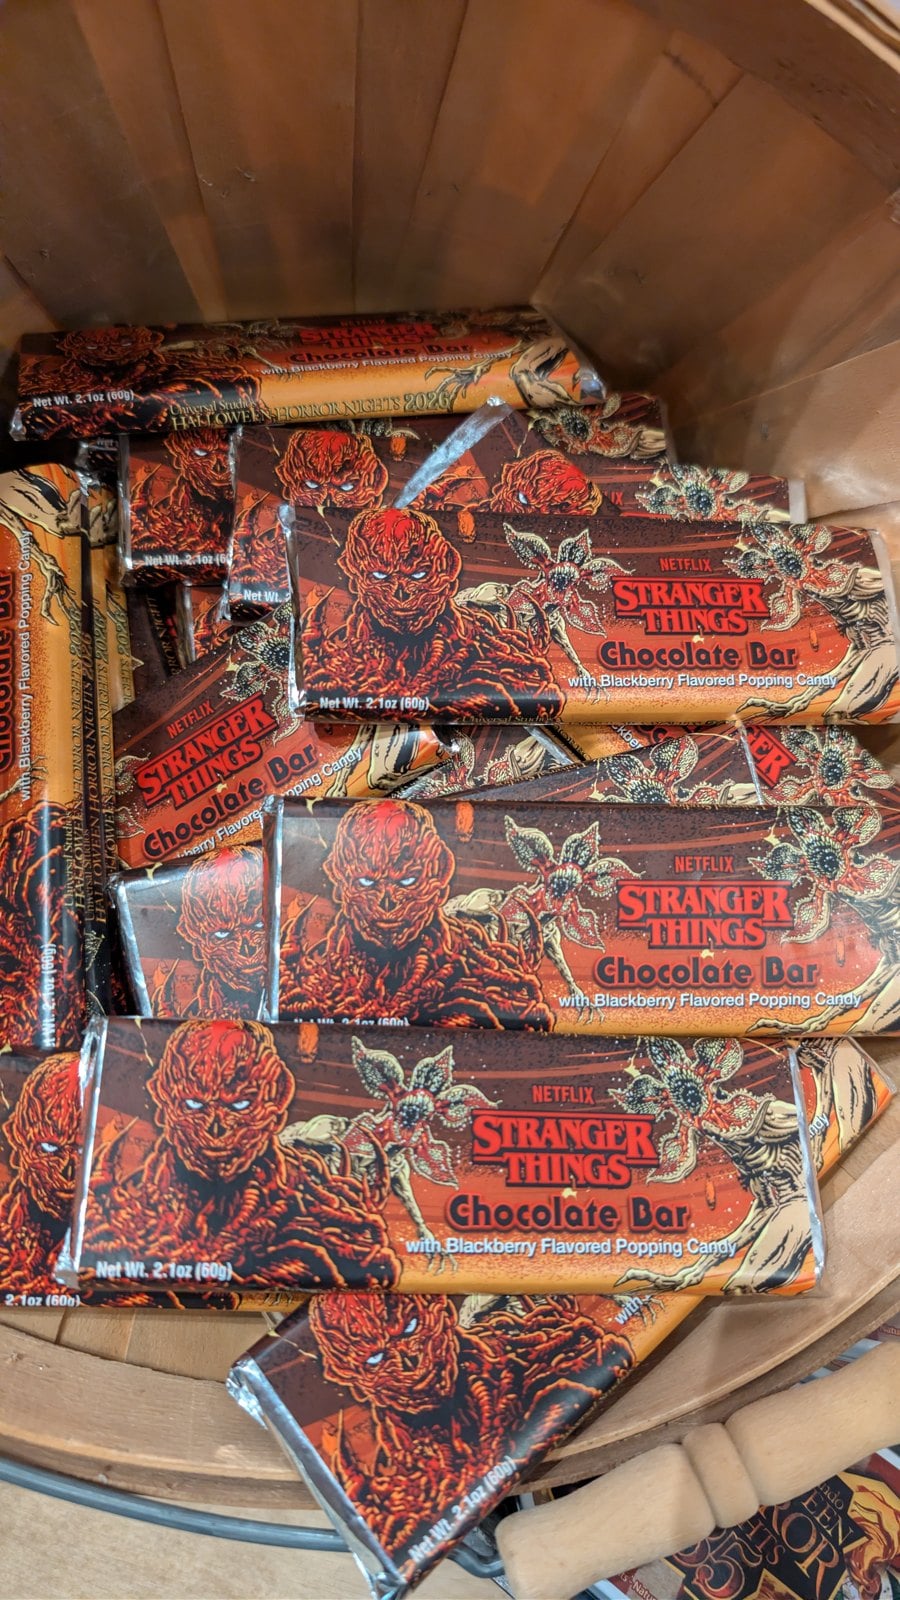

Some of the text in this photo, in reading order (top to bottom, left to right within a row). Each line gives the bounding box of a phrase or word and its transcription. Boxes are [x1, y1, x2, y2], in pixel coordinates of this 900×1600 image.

[260, 350, 513, 375] with Blackberry Flavored Popping Candy
[290, 343, 471, 363] Chocolate Bar
[33, 389, 134, 408] Net Wt. 2.1oz (60g)
[169, 397, 257, 416] Universal Studios
[171, 391, 450, 432] HALLOWEEN HORROR NIGHTS 2026
[144, 554, 163, 566] Net
[164, 554, 183, 566] Wt.
[185, 553, 214, 565] 2.1oz
[660, 557, 712, 573] NETFLIX
[243, 590, 262, 601] Net
[265, 591, 283, 603] Wt.
[612, 579, 771, 614] STRANGER
[642, 608, 749, 635] THINGS
[19, 530, 33, 801] with Blackberry Flavored Popping Candy
[600, 641, 797, 667] Chocolate Bar
[568, 672, 838, 689] with Blackberry Flavored Popping Candy
[82, 683, 97, 742] NIGHTS
[320, 696, 430, 711] Net Wt. 2.1oz (60g)
[166, 701, 215, 739] NETFLIX
[136, 698, 276, 803] STRANGER
[86, 744, 100, 813] HORROR
[166, 735, 263, 809] THINGS
[144, 744, 317, 857] Chocolate Bar
[217, 809, 262, 842] Flavore
[284, 773, 322, 797] pping
[322, 746, 362, 777] Candy
[674, 855, 735, 874] NETFLIX
[63, 853, 74, 907] Universal
[618, 884, 794, 924] STRANGER
[648, 918, 767, 947] THINGS
[40, 943, 58, 974] (60g)
[596, 955, 819, 985] Chocolate Bar
[559, 992, 862, 1010] with Blackberry Flavored Popping Candy
[532, 1084, 596, 1105] NETFLIX
[472, 1116, 658, 1164] STRANGER
[504, 1153, 632, 1187] THINGS
[447, 1194, 689, 1228] Chocolate Bar
[406, 1237, 738, 1257] with Blackberry Flavored Popping Candy
[95, 1261, 233, 1281] Net Wt. 2.1oz (60g)
[5, 1294, 81, 1308] 2.1oz (60g)
[408, 1455, 518, 1562] Net Wt. 2.1oz (60g)
